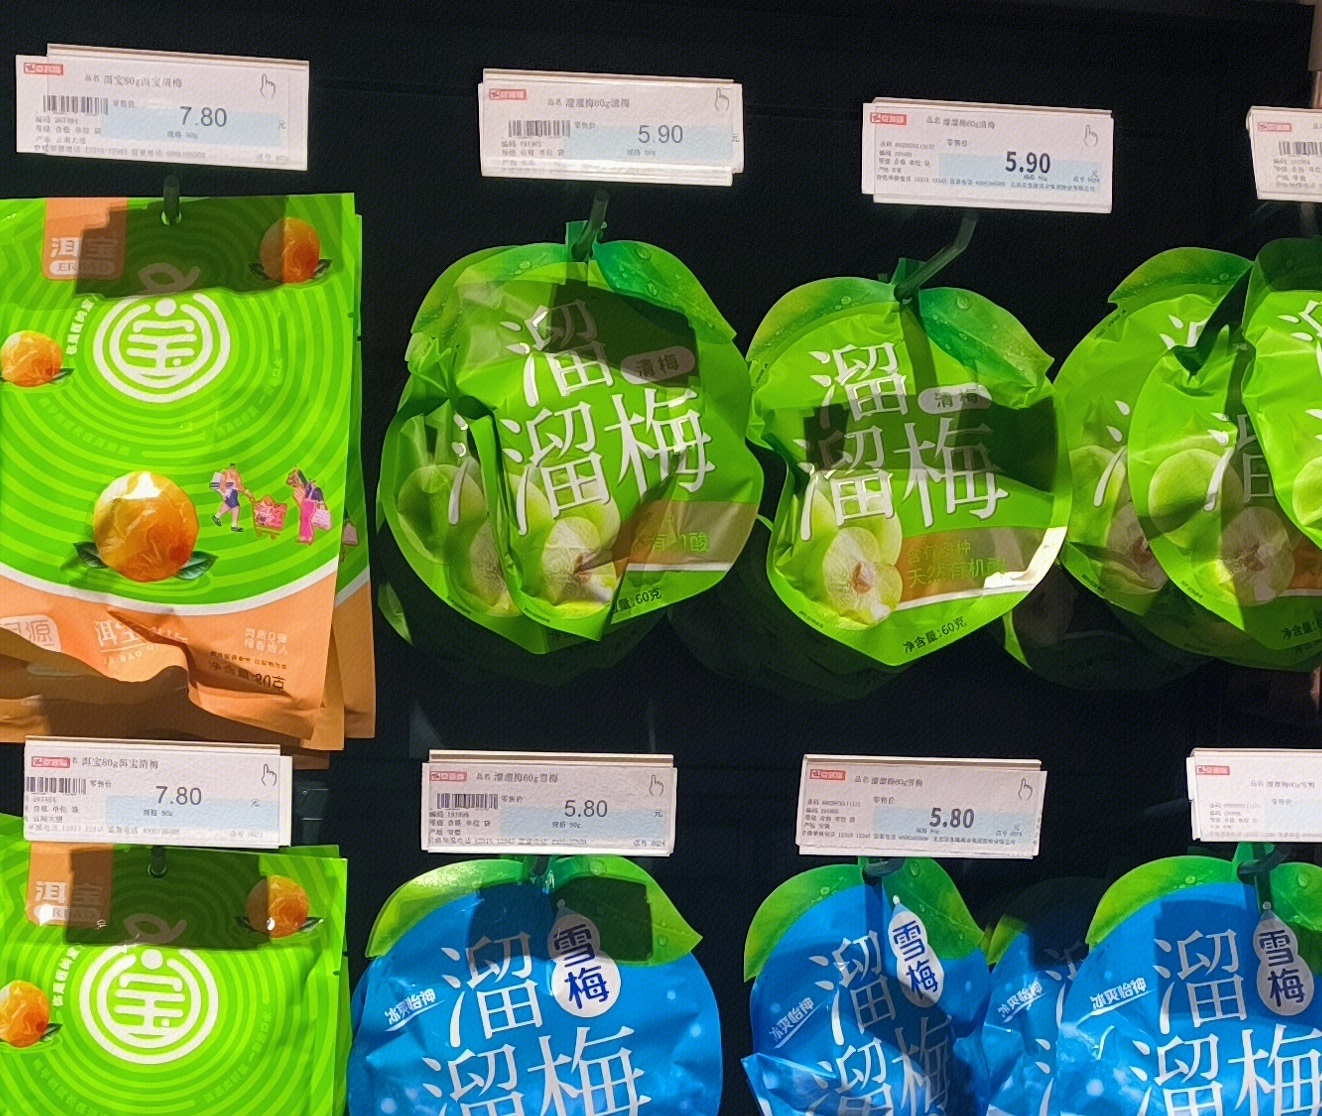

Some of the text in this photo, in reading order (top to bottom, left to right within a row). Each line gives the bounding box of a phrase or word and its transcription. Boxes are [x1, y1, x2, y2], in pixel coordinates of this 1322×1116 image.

[179, 105, 228, 128] 7.80
[637, 123, 684, 146] 5.90
[1005, 150, 1051, 175] 5.90
[49, 235, 119, 260] 洱宝
[499, 387, 717, 537] 溜梅
[792, 417, 1010, 542] 溜梅
[902, 616, 968, 654] 净含量:60克
[155, 784, 203, 808] 7.80
[564, 798, 609, 819] 5.80
[928, 806, 976, 831] 5.80
[34, 880, 103, 904] 洱宝
[552, 922, 611, 1010] 雪梅
[891, 920, 940, 1001] 雪梅
[1257, 928, 1307, 1008] 雪梅
[440, 930, 544, 1048] 溜
[1089, 976, 1148, 1011] 冰爽怡神
[1152, 928, 1248, 1036] 溜
